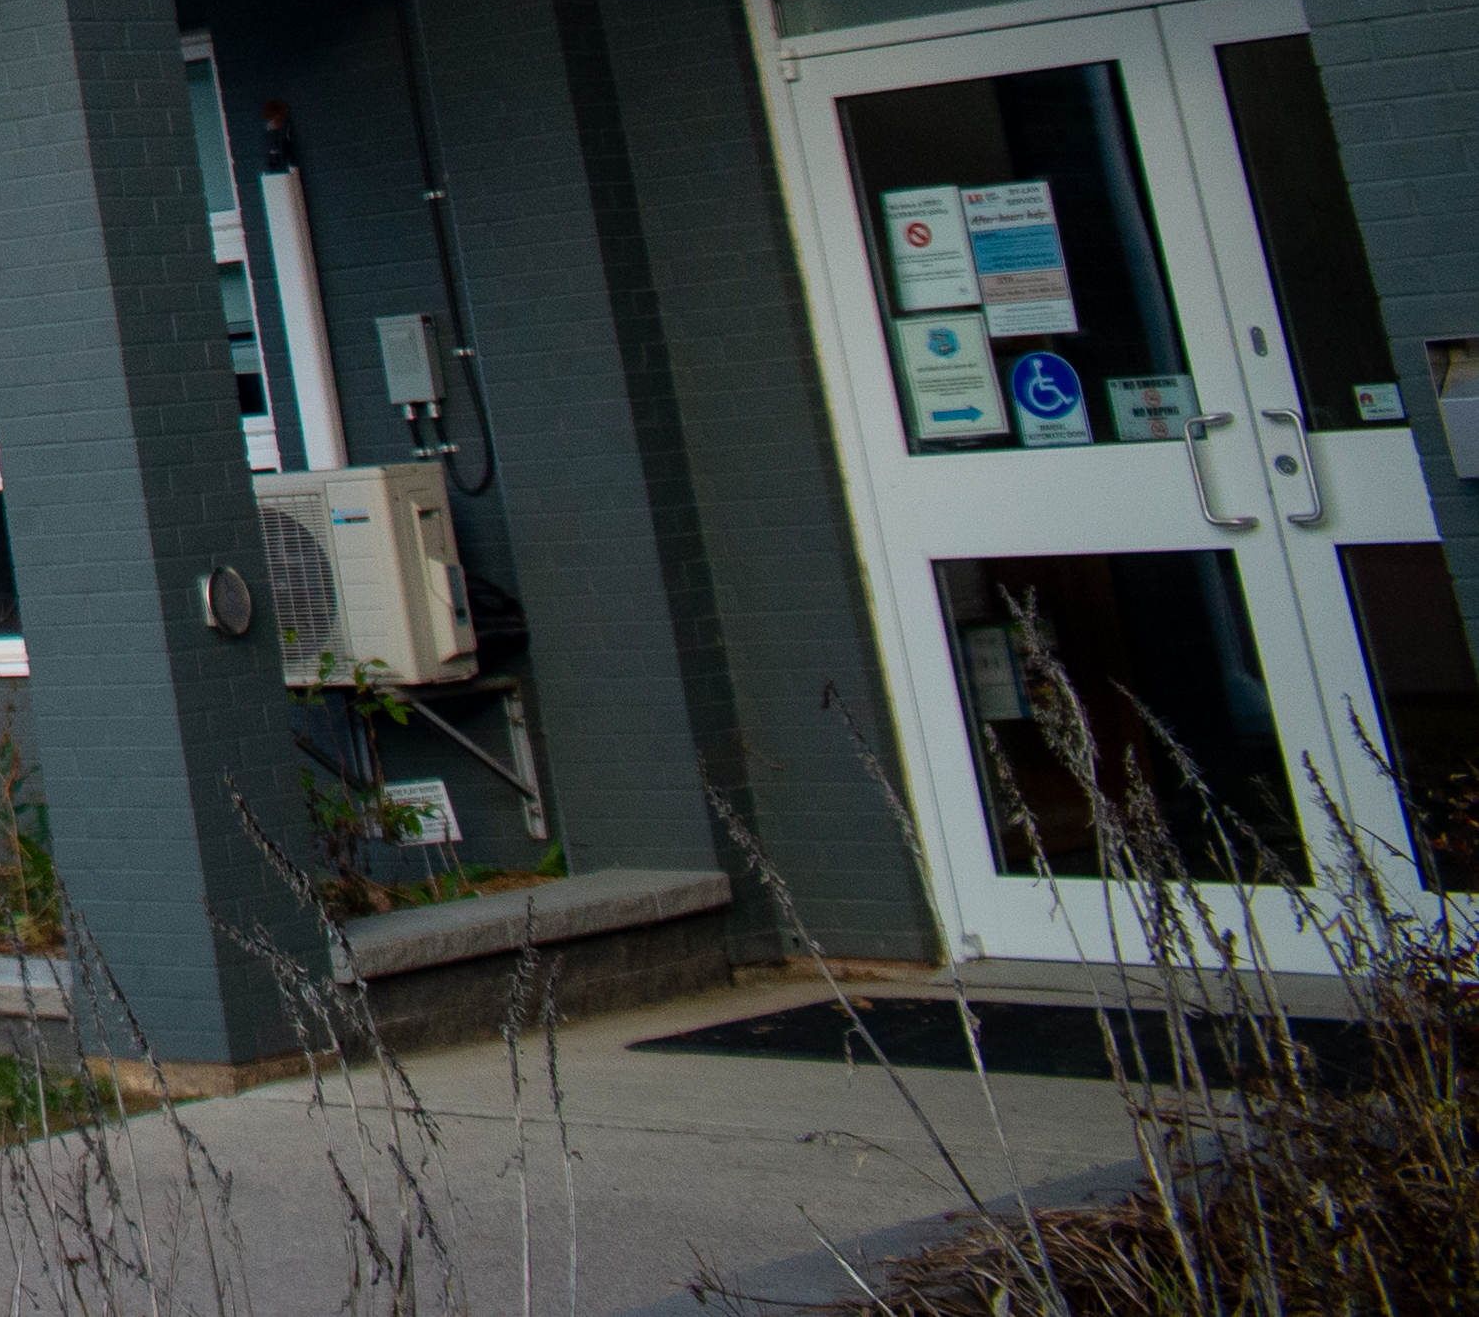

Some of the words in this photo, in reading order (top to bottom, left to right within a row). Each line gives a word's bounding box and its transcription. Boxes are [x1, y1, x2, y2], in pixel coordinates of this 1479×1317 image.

[1122, 380, 1135, 390] NO
[1136, 378, 1179, 390] SMOKING
[1133, 407, 1146, 417] NO
[1146, 405, 1180, 417] VAPING
